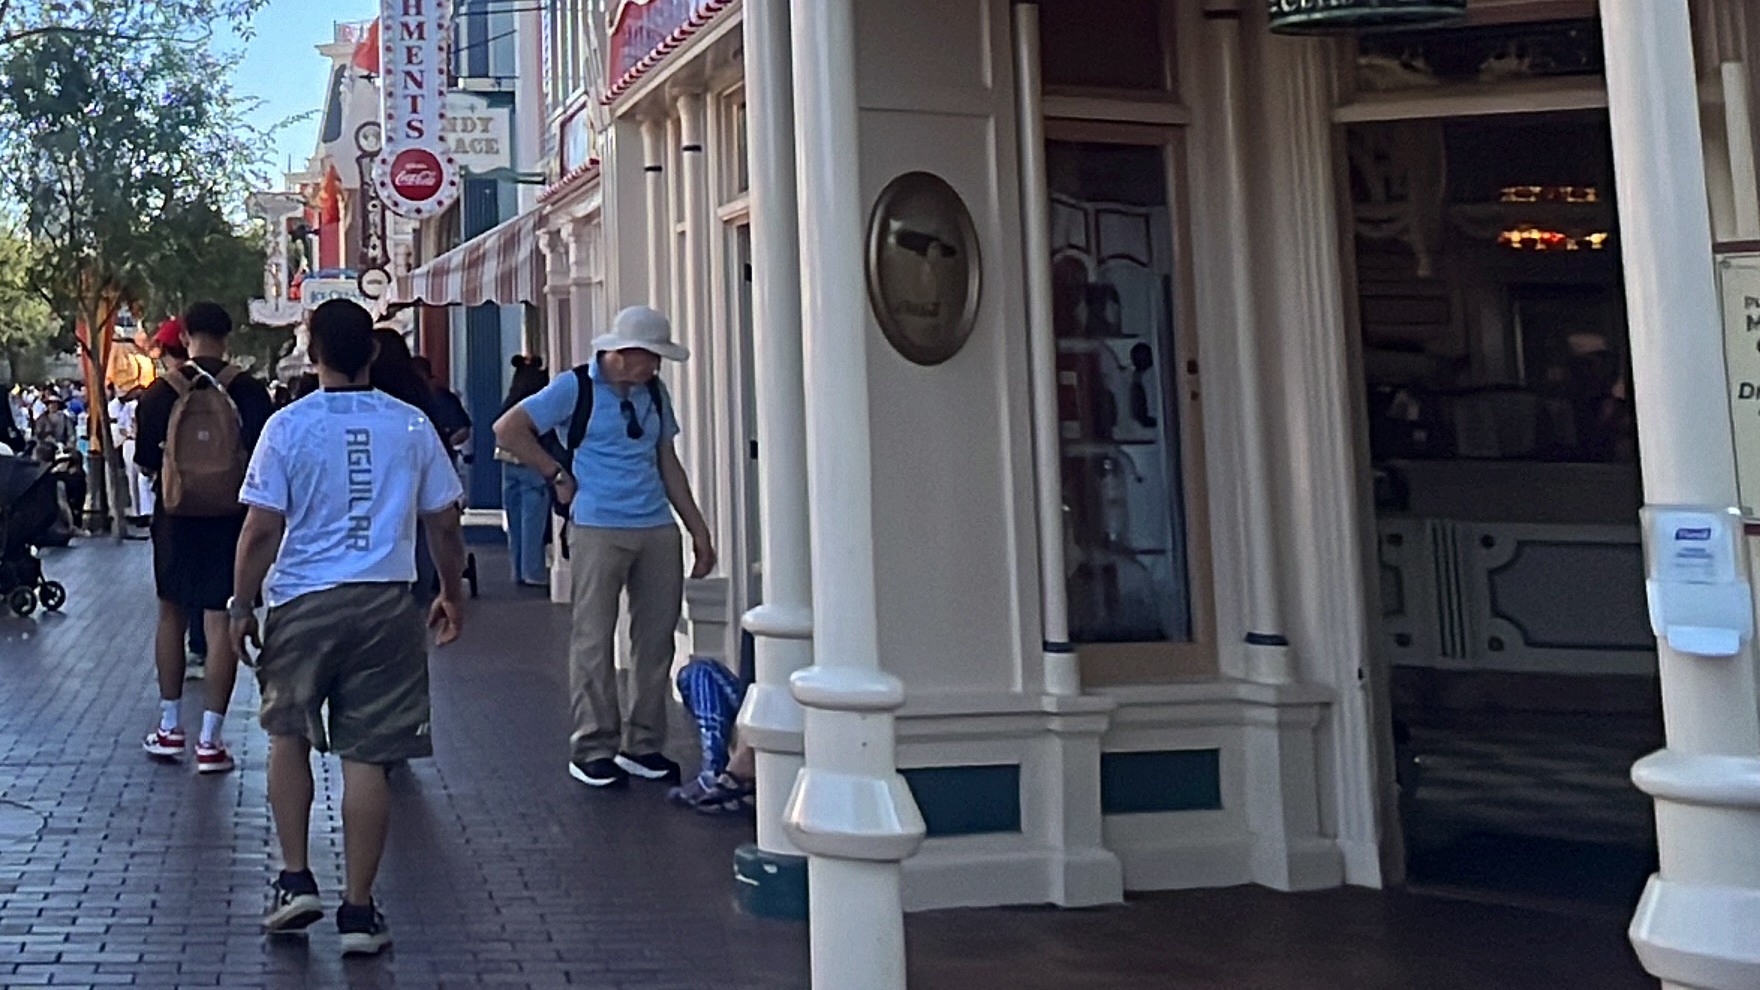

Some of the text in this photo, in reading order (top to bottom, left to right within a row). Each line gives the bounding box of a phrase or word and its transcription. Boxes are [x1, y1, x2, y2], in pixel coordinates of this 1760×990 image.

[441, 116, 493, 133] NDY
[452, 137, 500, 154] ACE
[346, 428, 372, 550] AGUILAR
